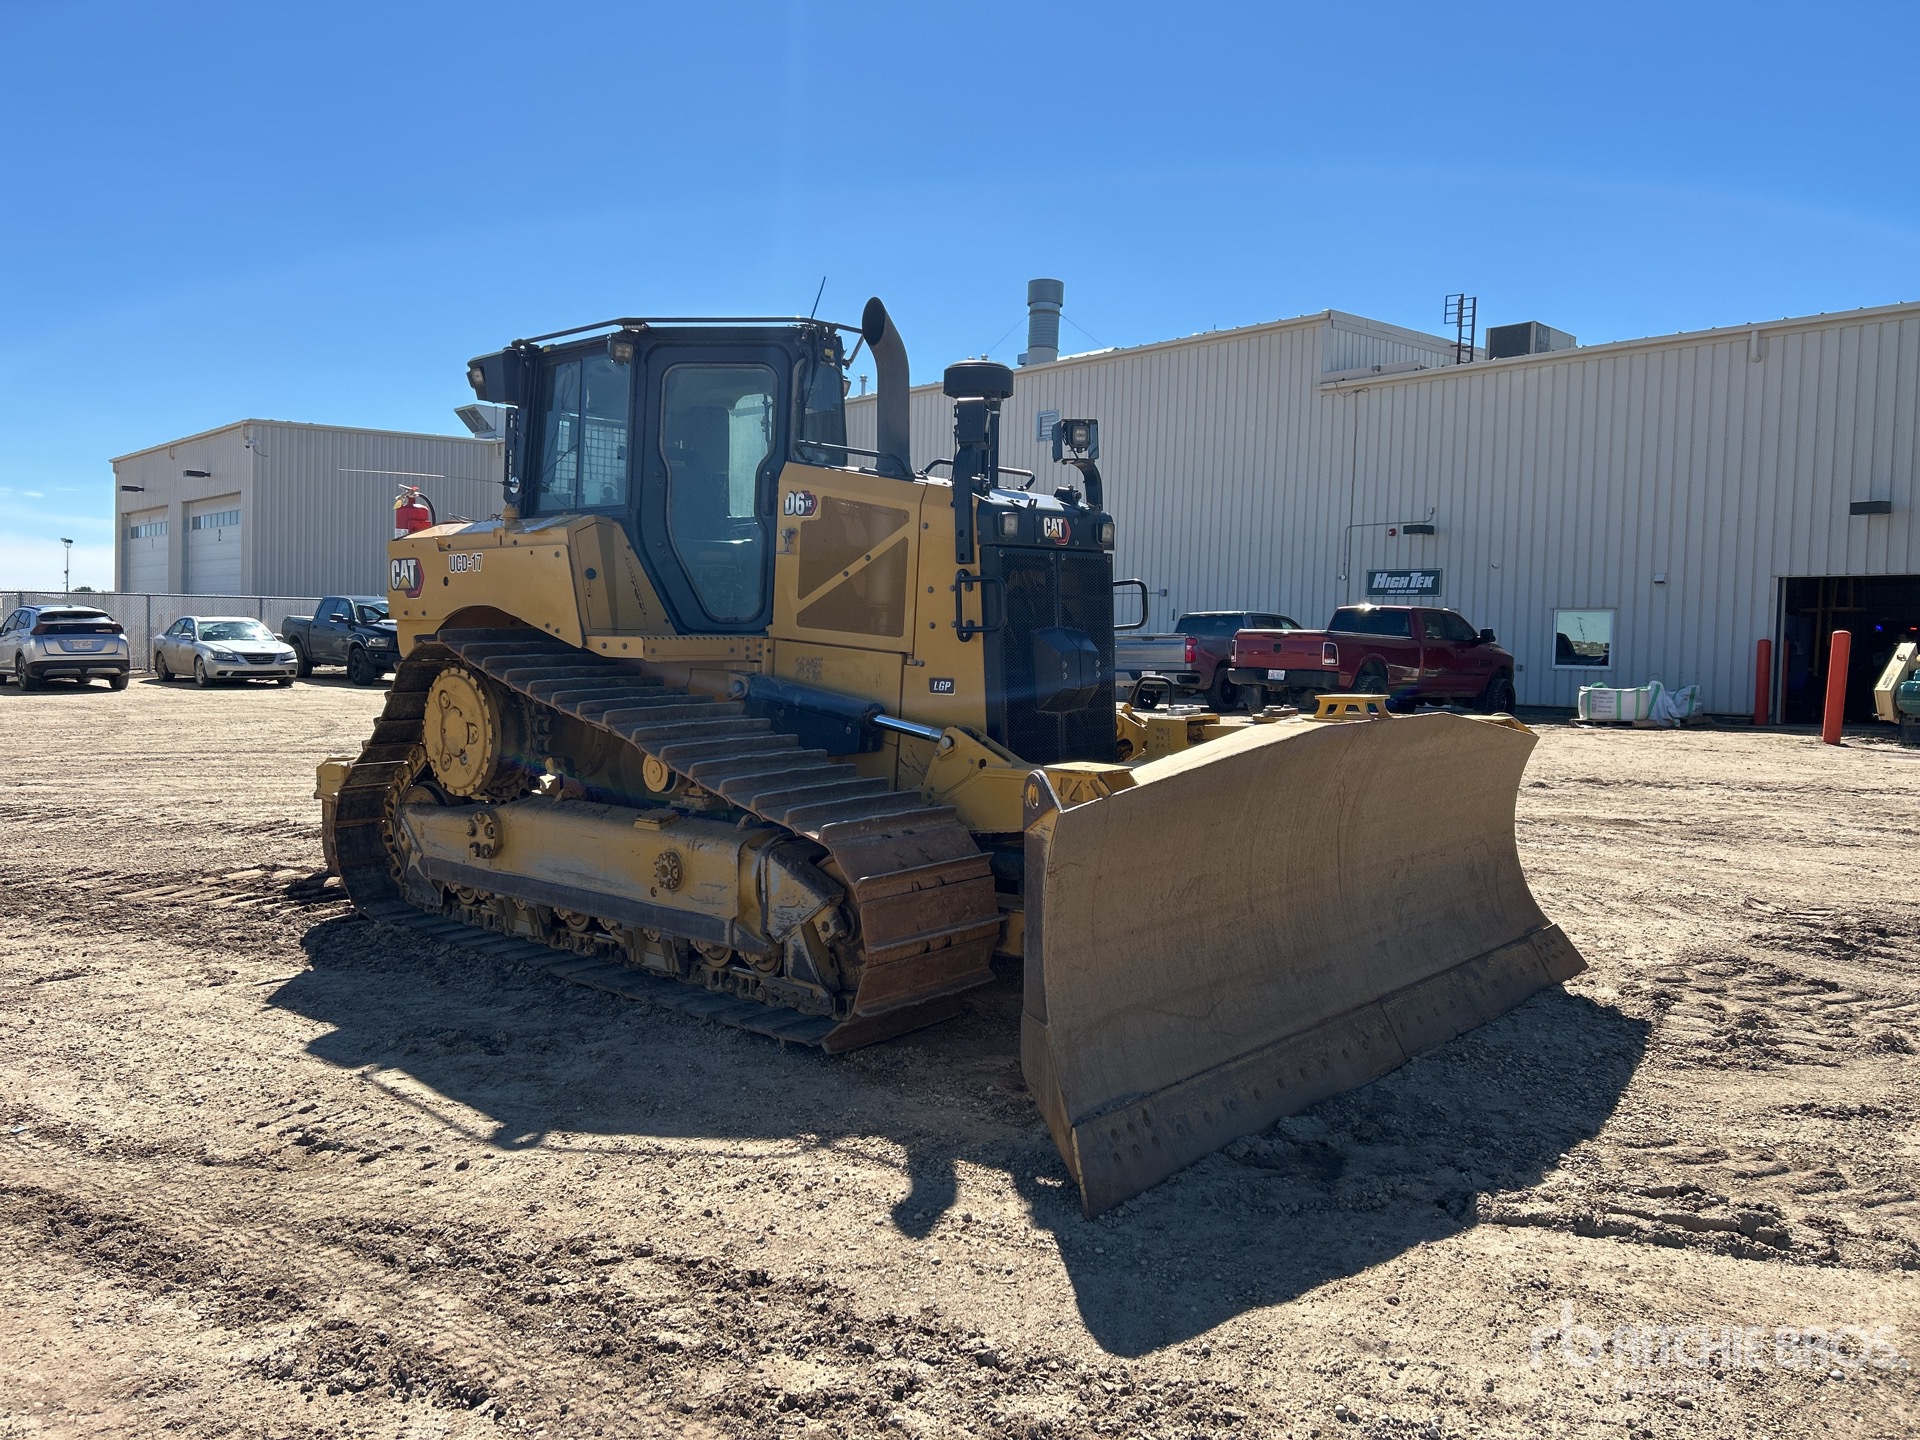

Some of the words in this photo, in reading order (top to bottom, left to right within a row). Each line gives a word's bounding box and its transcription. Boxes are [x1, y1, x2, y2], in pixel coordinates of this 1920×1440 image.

[784, 492, 805, 515] D6
[1043, 516, 1065, 539] CAT
[391, 559, 417, 590] CAT
[448, 552, 484, 574] UCD-17
[933, 680, 952, 691] LGP
